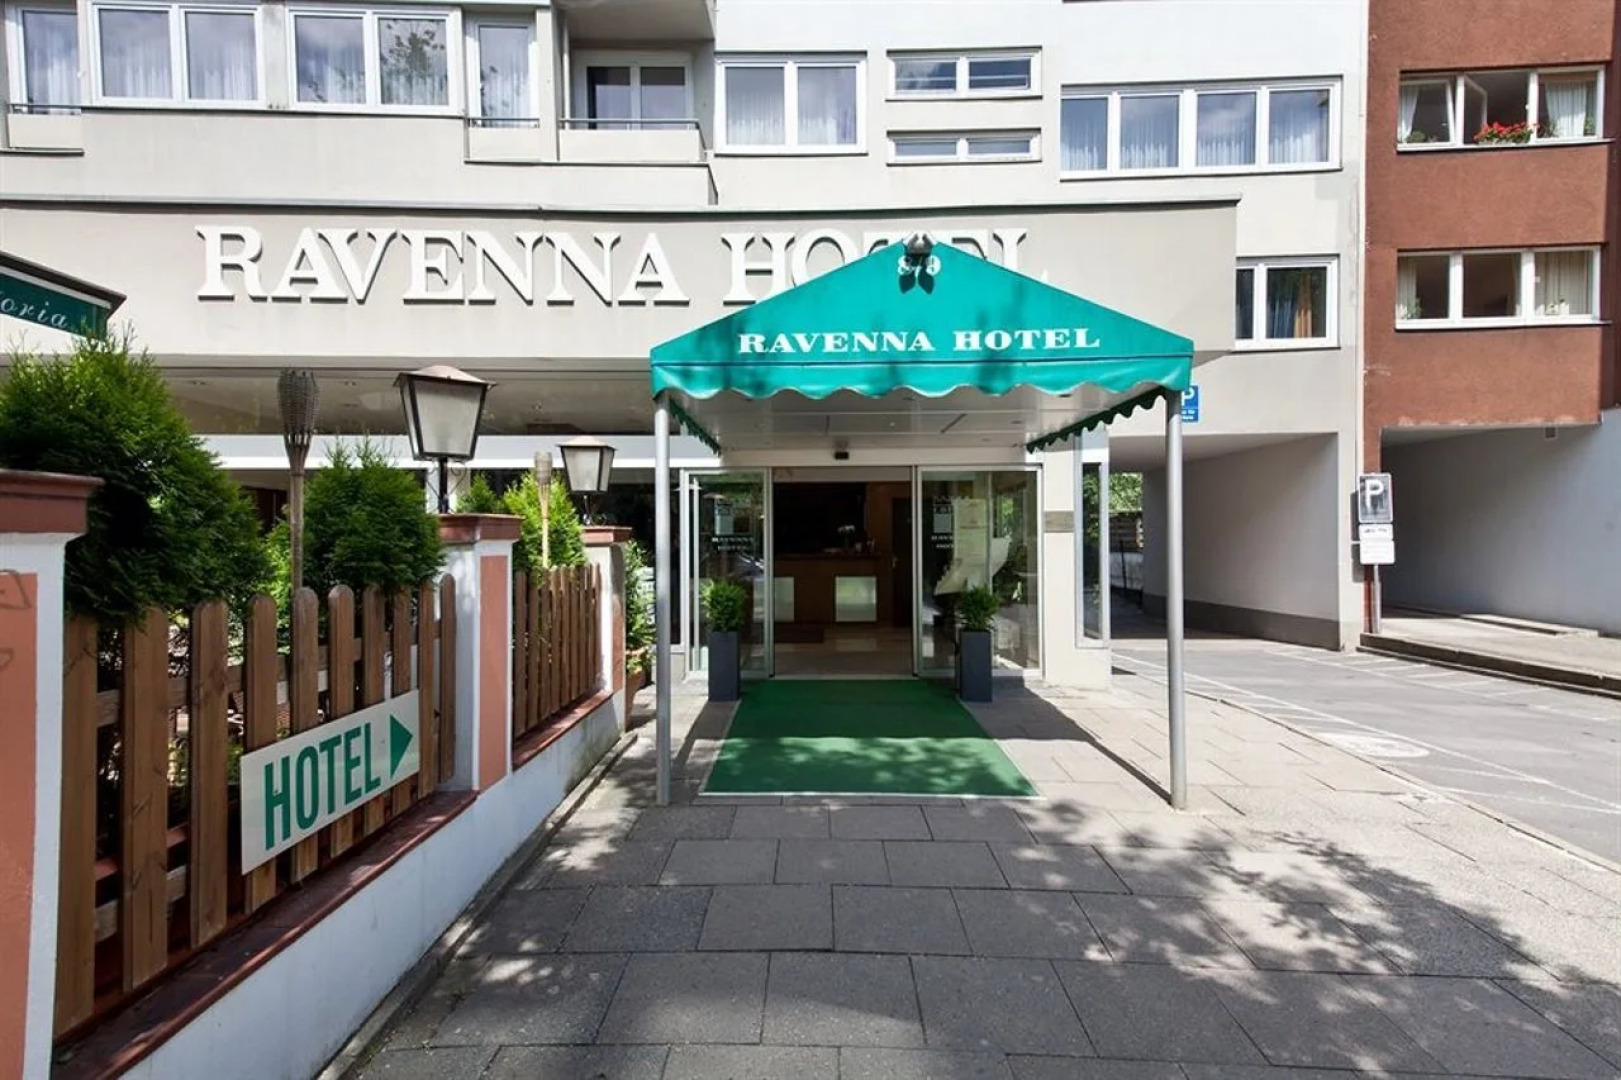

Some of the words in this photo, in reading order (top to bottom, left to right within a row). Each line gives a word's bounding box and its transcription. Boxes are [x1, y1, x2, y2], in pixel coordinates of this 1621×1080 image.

[195, 225, 691, 307] RAVENNA
[0, 291, 68, 328] oria
[738, 331, 936, 354] RAVENNA
[952, 327, 1101, 352] HOTEL
[1181, 386, 1196, 406] P
[1364, 479, 1385, 509] P
[264, 722, 381, 851] HOTEL
